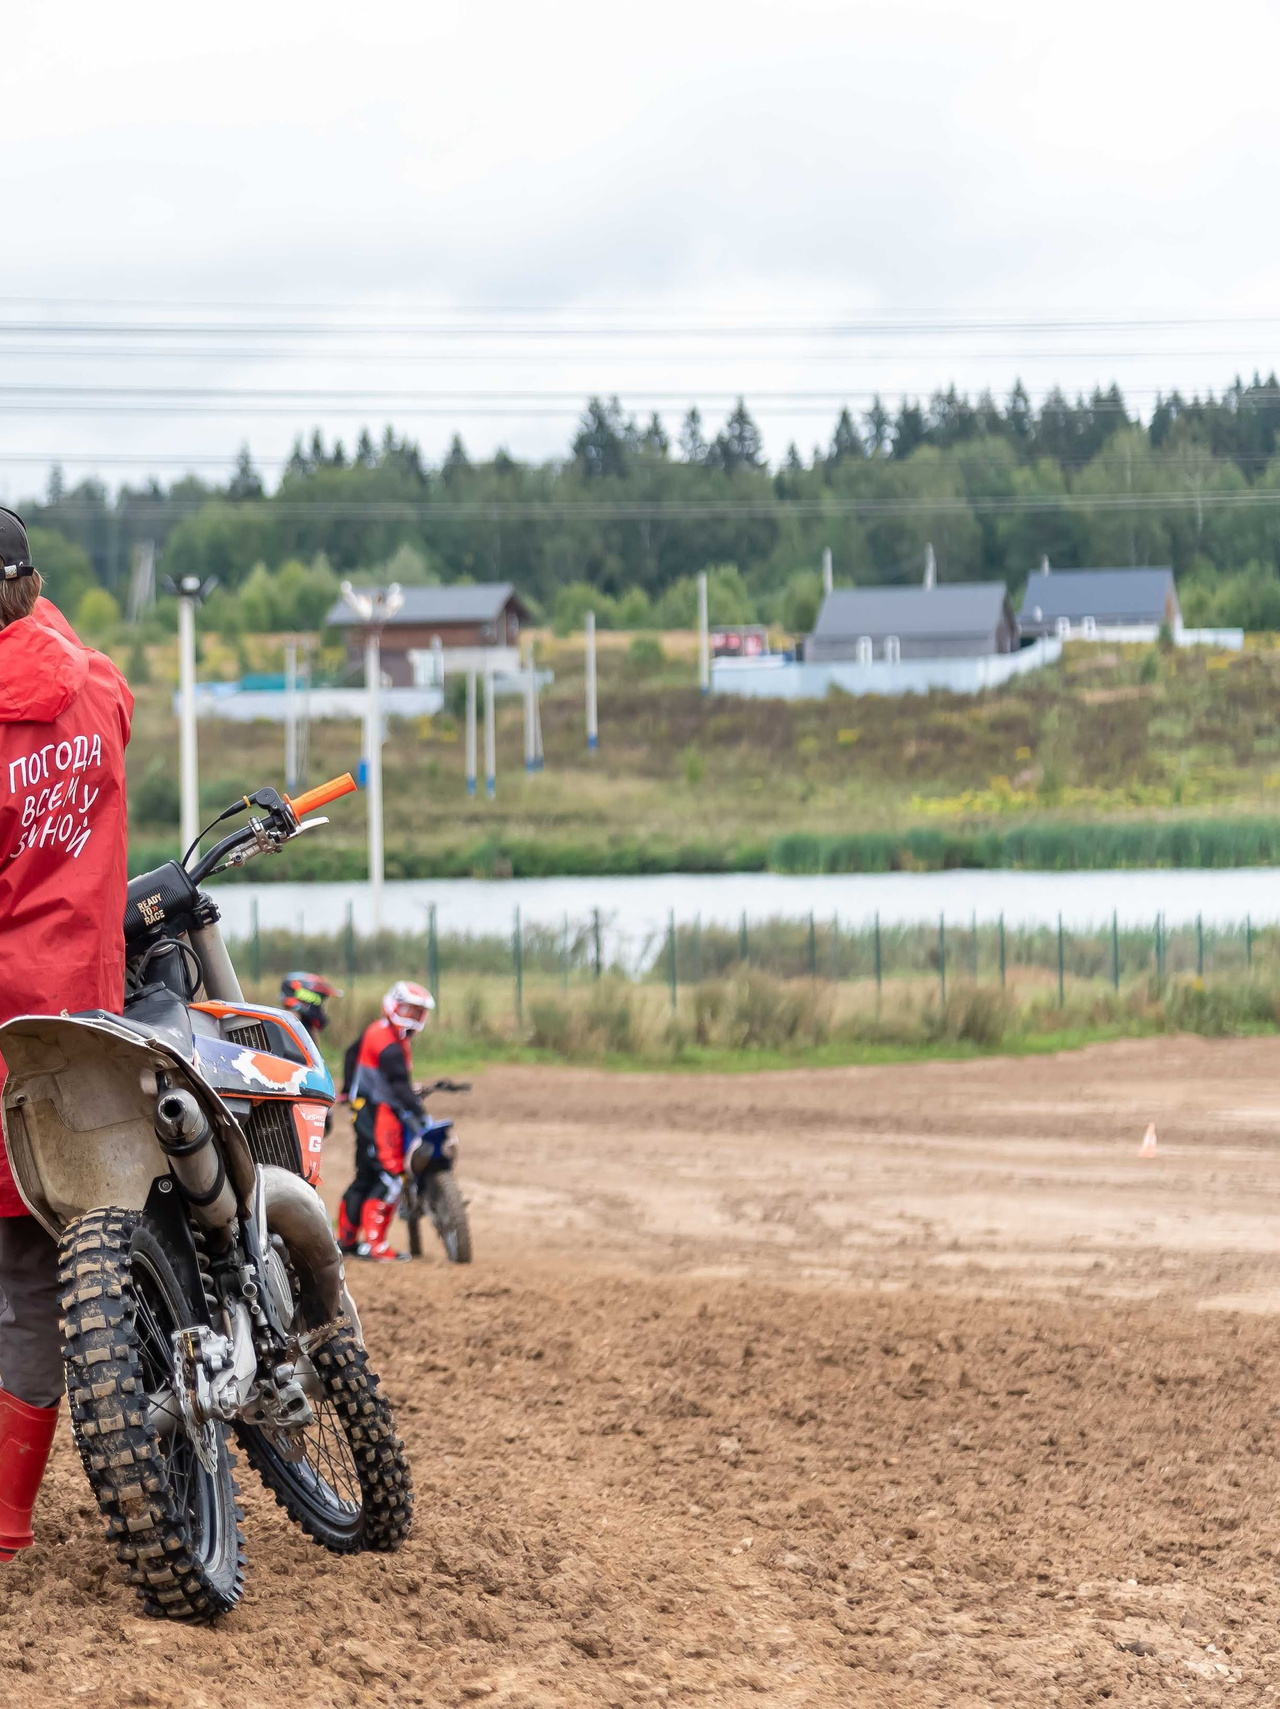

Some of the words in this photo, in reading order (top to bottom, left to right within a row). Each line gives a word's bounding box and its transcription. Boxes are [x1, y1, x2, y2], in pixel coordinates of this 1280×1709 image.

[8, 733, 101, 794] ПОГОДА
[21, 775, 99, 827] ВСЕМУ
[136, 892, 162, 911] READY
[141, 907, 153, 918] TO
[144, 909, 166, 926] RACE
